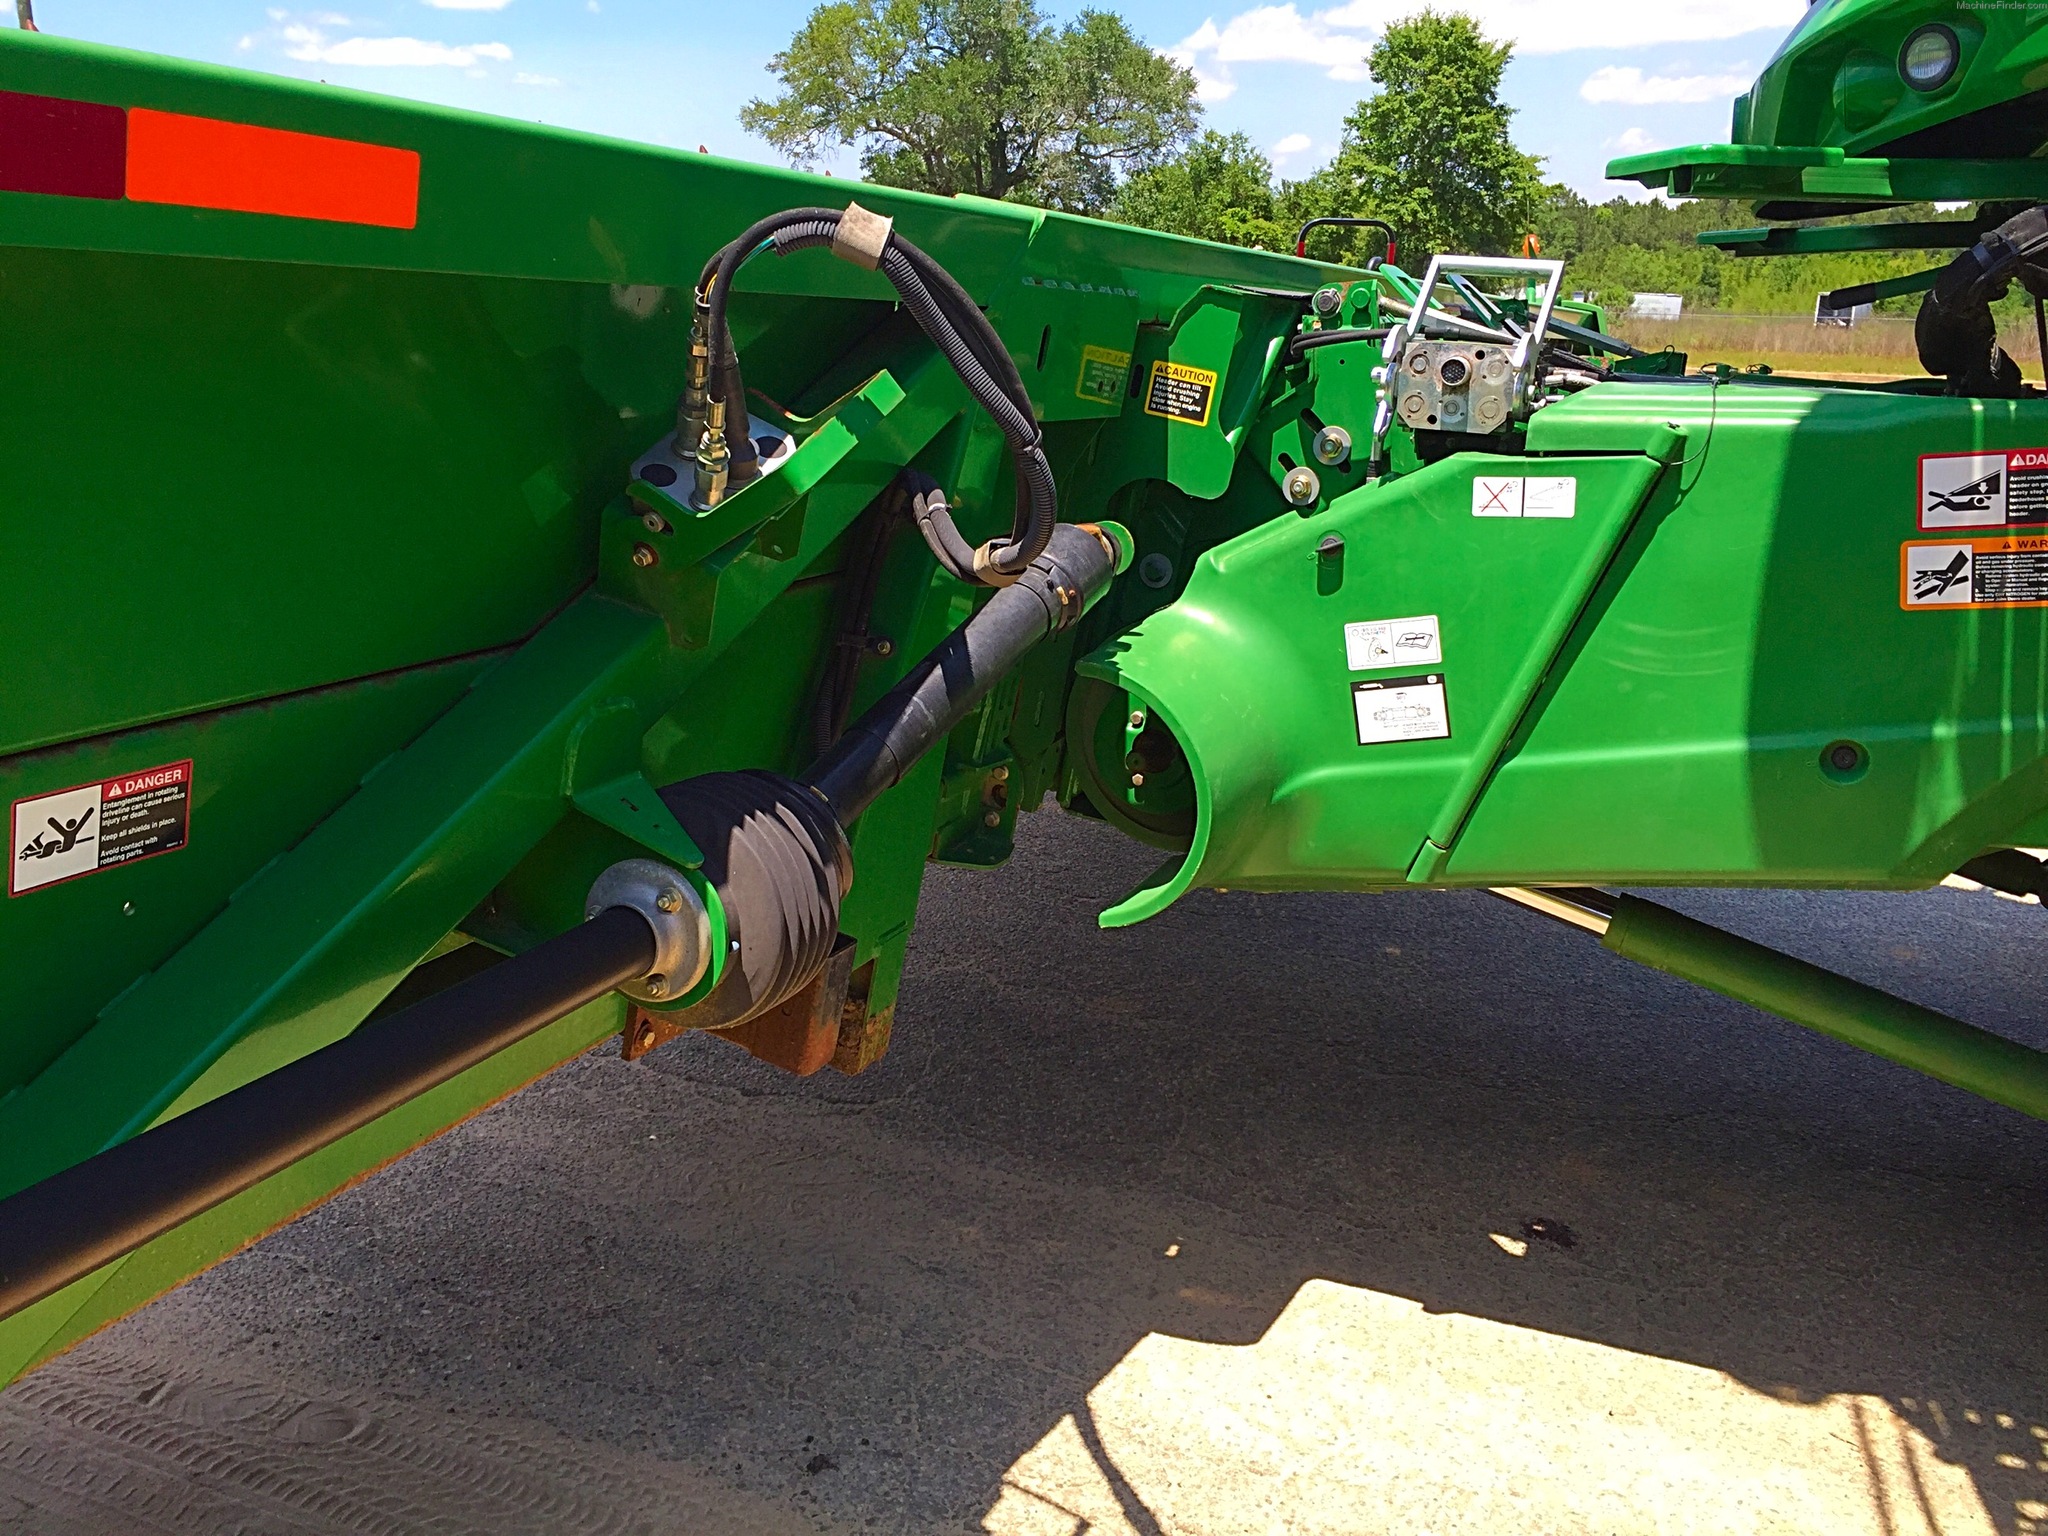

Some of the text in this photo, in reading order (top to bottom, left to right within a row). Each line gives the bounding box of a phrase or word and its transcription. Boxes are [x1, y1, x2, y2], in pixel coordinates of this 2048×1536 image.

[1156, 377, 1178, 386] Header
[1165, 366, 1213, 383] CAUTION
[1155, 383, 1200, 399] Avoid crushing
[1179, 395, 1194, 404] Stay
[1157, 405, 1181, 415] running.
[2026, 454, 2048, 465] DA
[125, 769, 182, 793] DANGER
[102, 807, 130, 818] driveline
[144, 798, 162, 808] cause
[164, 792, 185, 802] serious
[103, 794, 147, 810] Entanglement
[154, 786, 178, 797] rotating
[102, 816, 120, 827] injury
[130, 809, 149, 819] death.
[101, 833, 118, 842] Keep
[128, 824, 150, 835] shields
[159, 817, 176, 828] place.
[100, 847, 120, 857] Avoid
[120, 840, 144, 851] contact
[145, 836, 158, 845] with
[100, 848, 144, 865] rotating parts.
